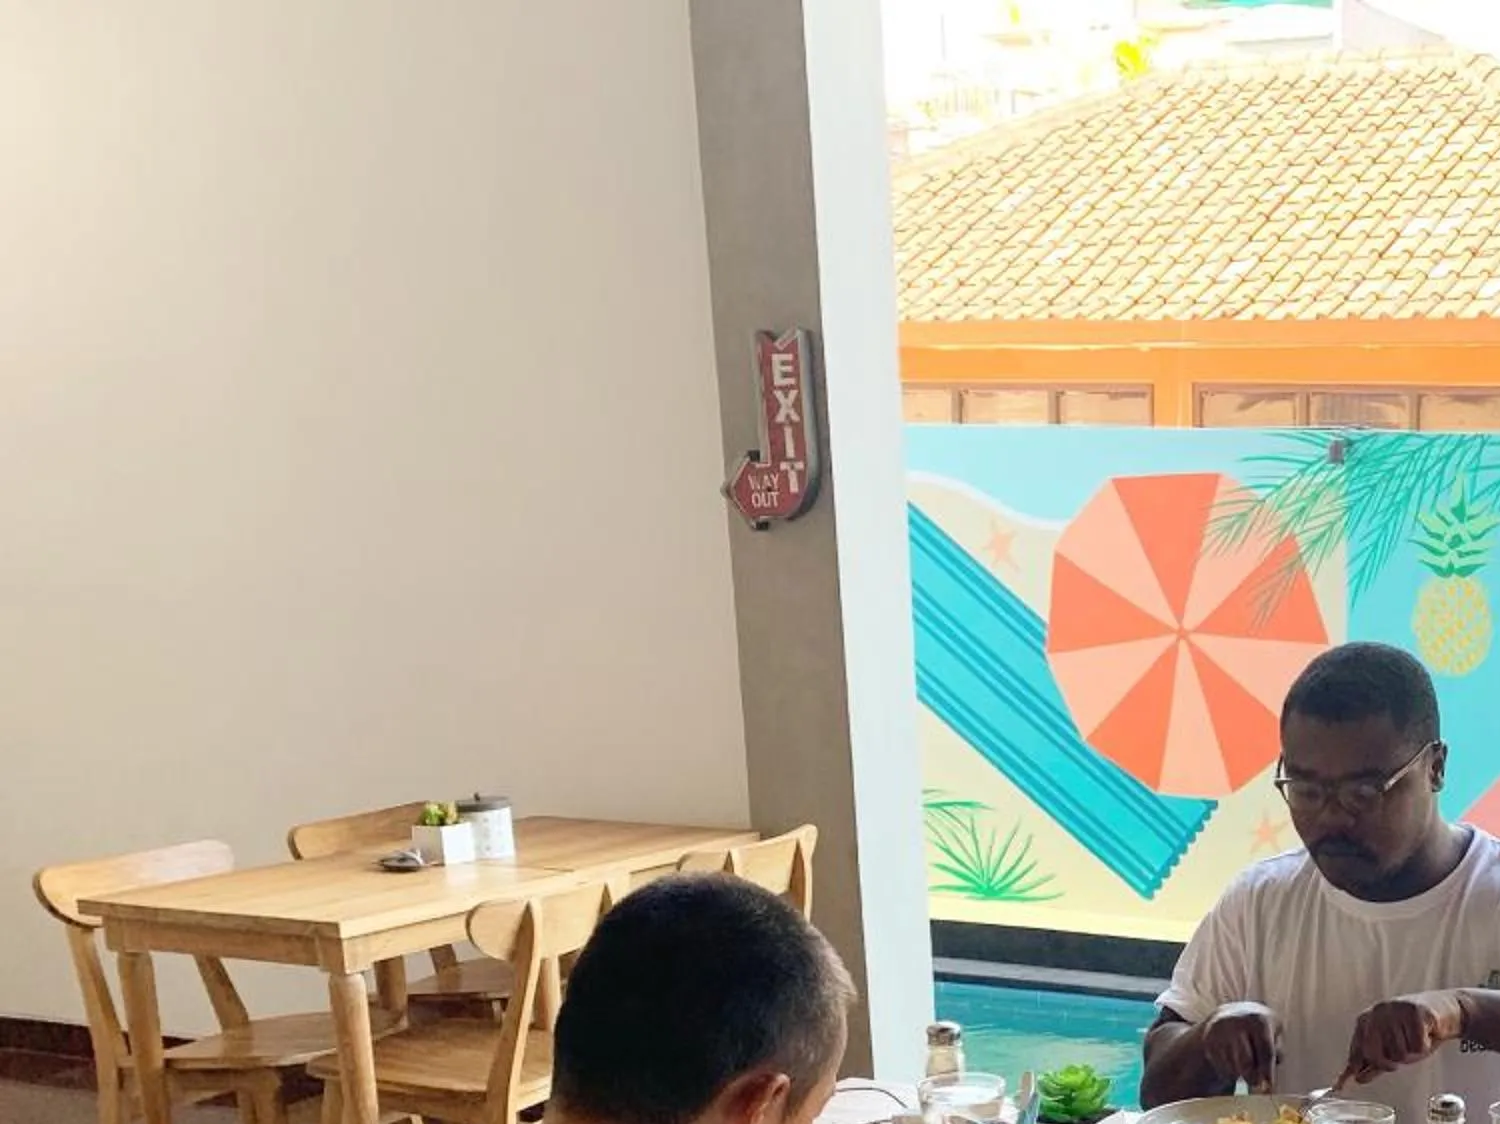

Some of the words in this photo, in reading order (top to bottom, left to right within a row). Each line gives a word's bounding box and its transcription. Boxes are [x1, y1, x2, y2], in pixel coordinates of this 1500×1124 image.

[771, 353, 805, 494] EXIT
[748, 473, 780, 491] WAY
[751, 492, 780, 508] OUT
